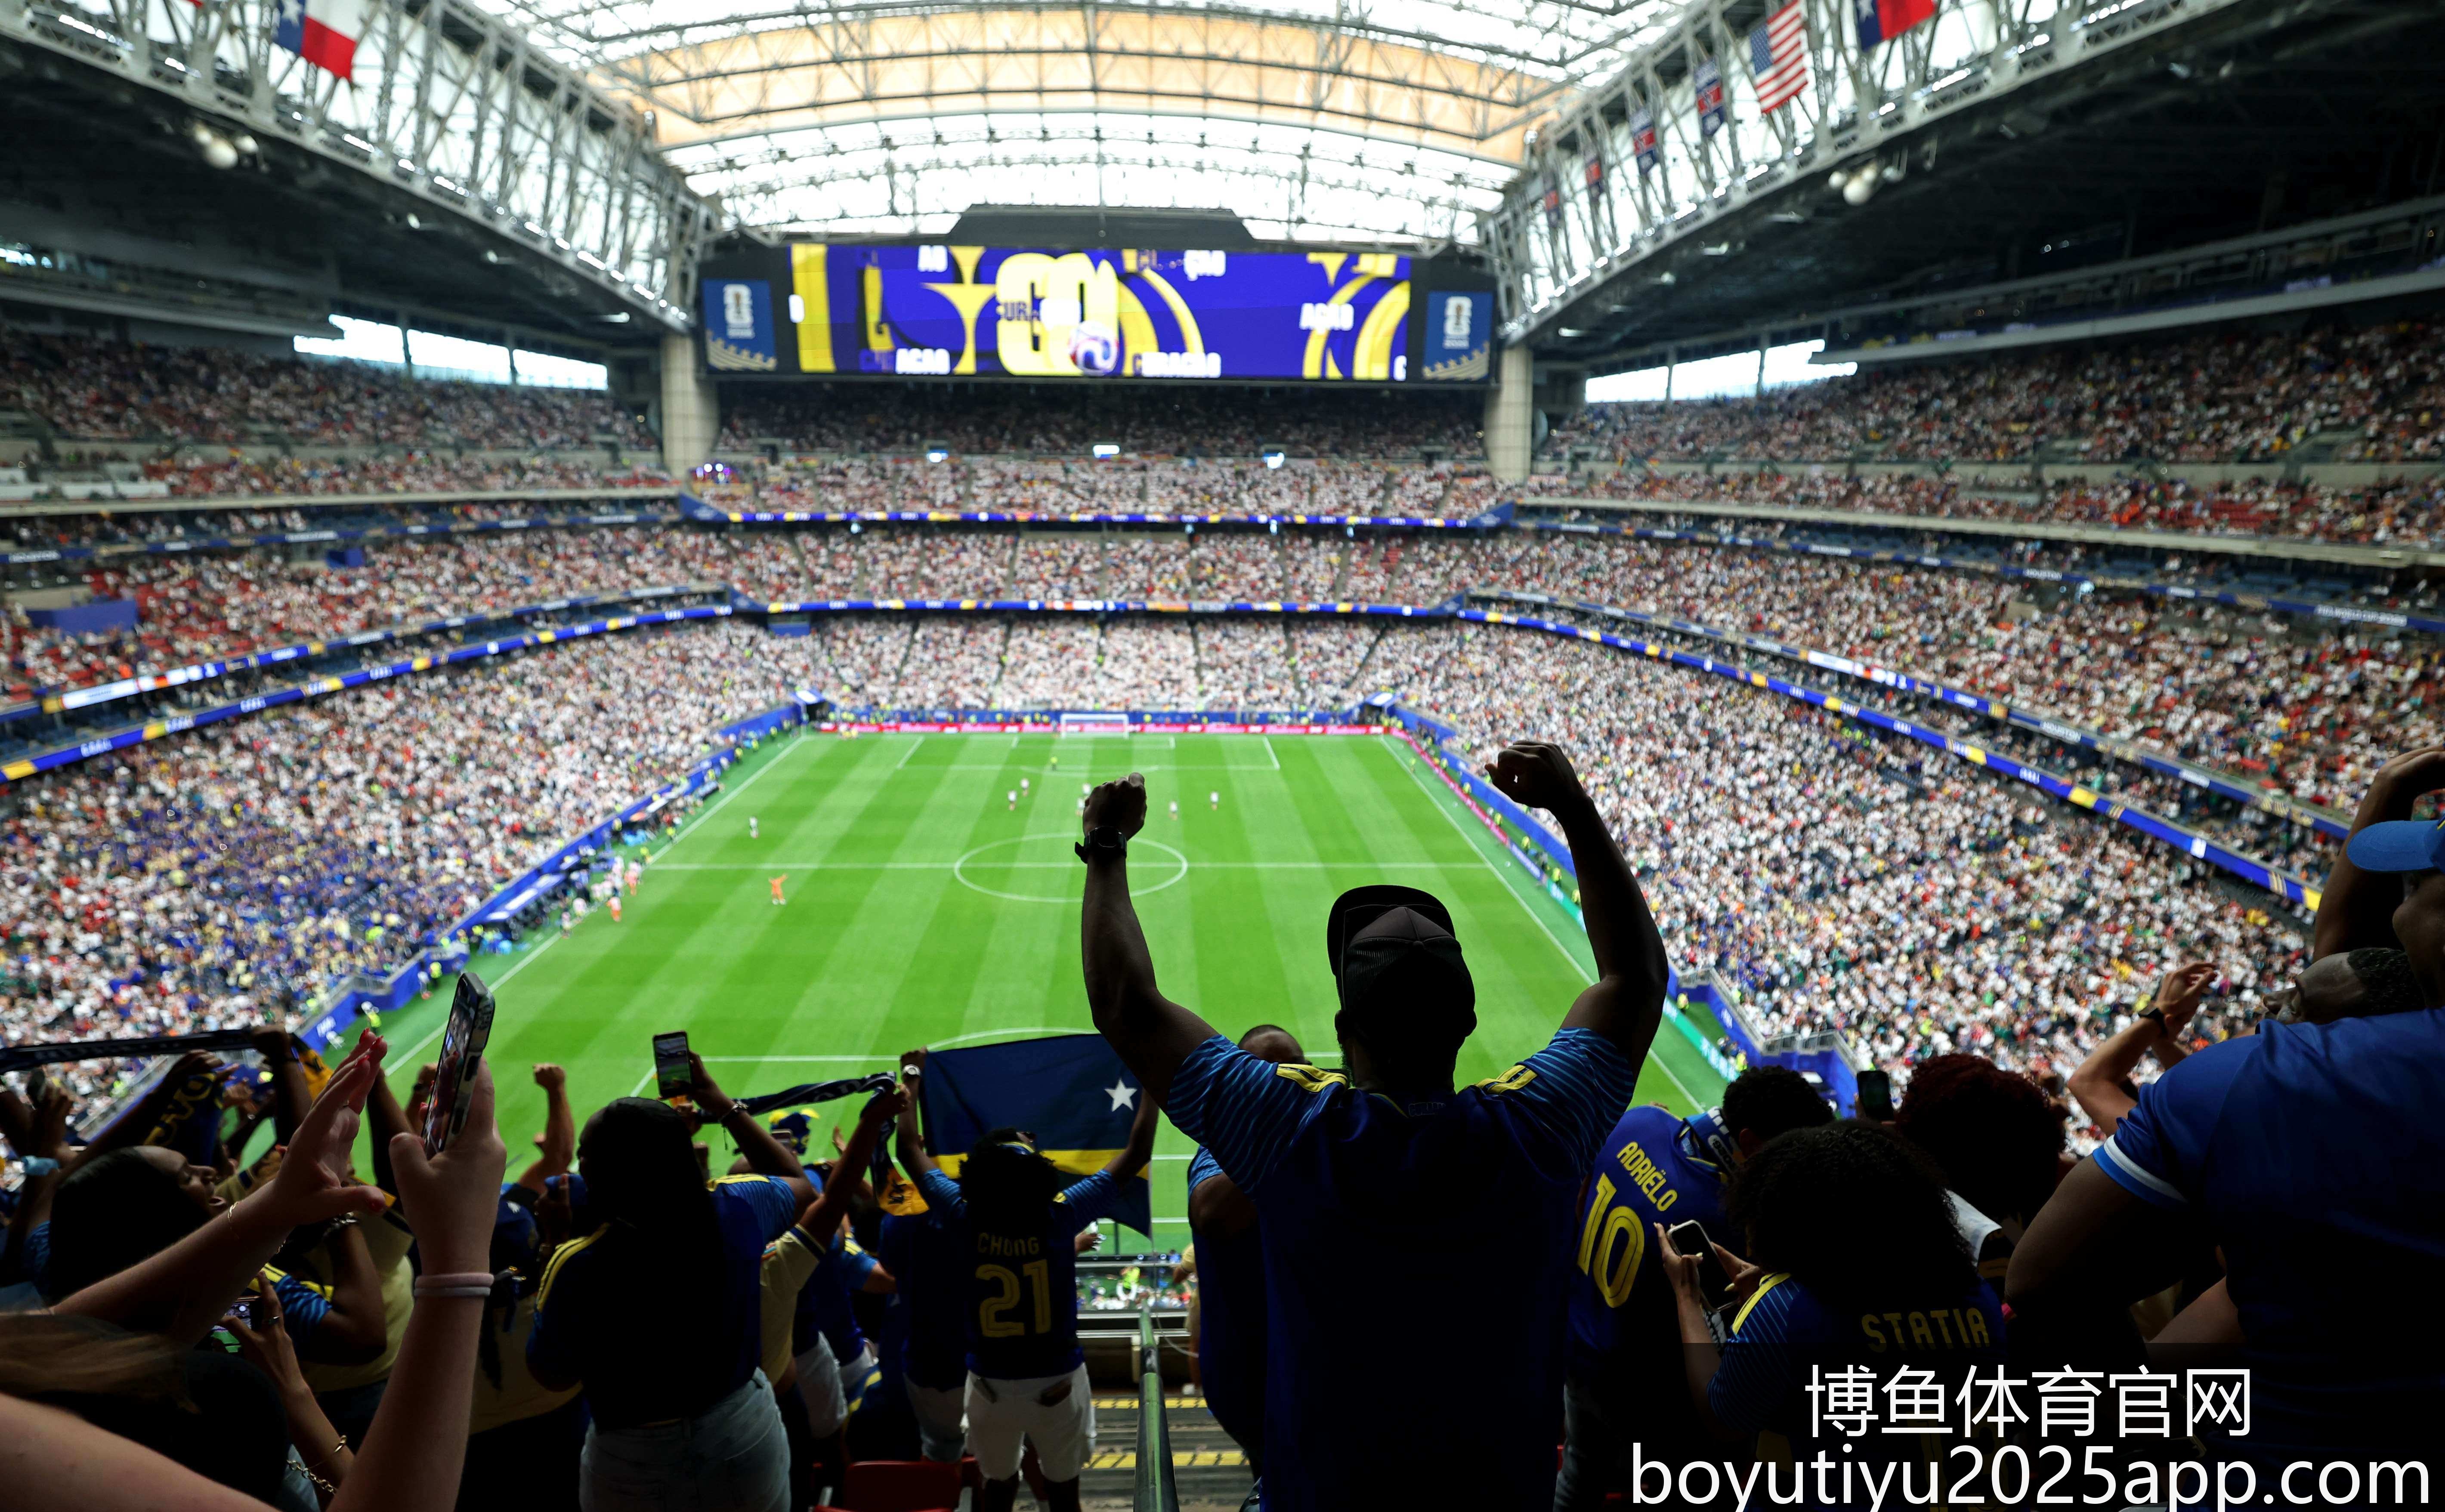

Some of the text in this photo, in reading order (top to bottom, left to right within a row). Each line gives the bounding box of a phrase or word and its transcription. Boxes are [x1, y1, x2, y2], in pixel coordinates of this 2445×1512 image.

[1617, 1142, 1677, 1211] ADRIËLO
[977, 1232, 1039, 1256] CHONG
[1577, 1173, 1644, 1308] 10
[976, 1259, 1051, 1337] 21
[1861, 1307, 1990, 1353] STATIA
